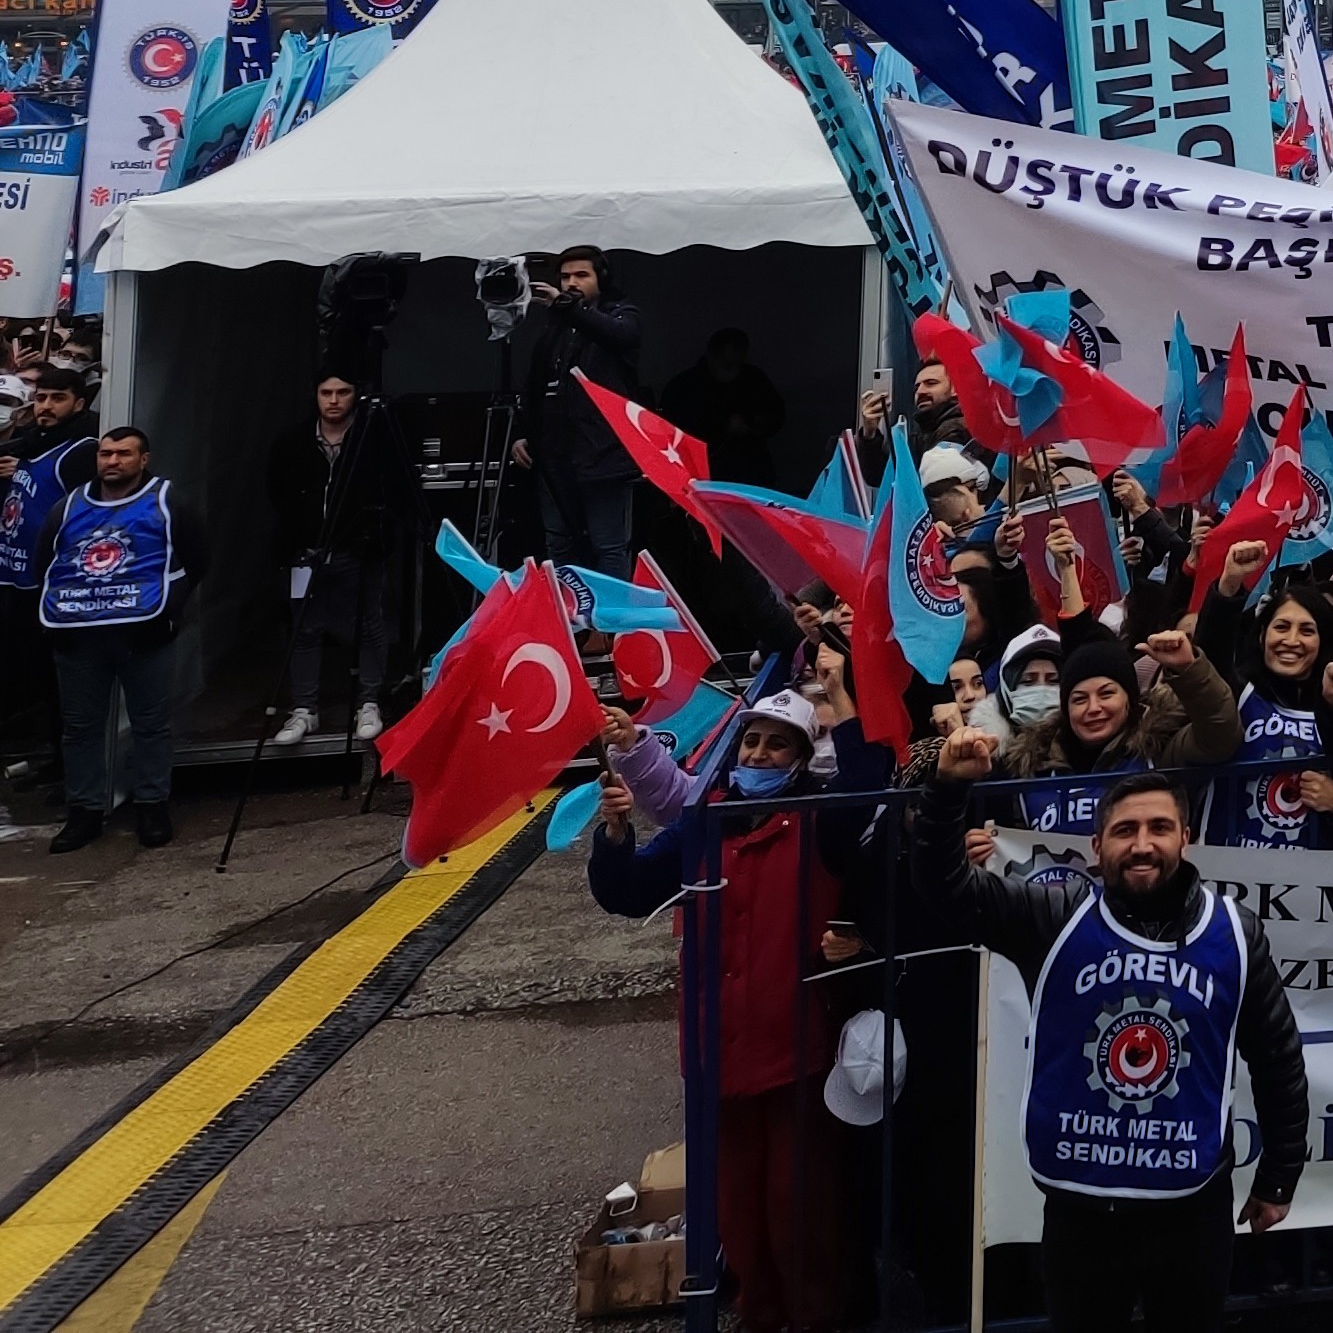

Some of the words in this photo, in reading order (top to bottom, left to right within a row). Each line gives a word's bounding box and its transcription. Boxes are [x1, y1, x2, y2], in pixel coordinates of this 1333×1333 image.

[140, 75, 182, 88] 1952
[20, 150, 64, 166] mobil
[927, 137, 1191, 210] DÜŞTÜK
[1074, 950, 1215, 1010] GÖREVLİ
[1099, 1029, 1116, 1062] TÜRK
[1113, 1014, 1146, 1033] METAL
[1147, 1014, 1178, 1068] SENDİKASI
[1058, 1109, 1121, 1138] TÜRK
[1127, 1117, 1198, 1142] METAL
[1054, 1140, 1198, 1170] SENDİKASI
